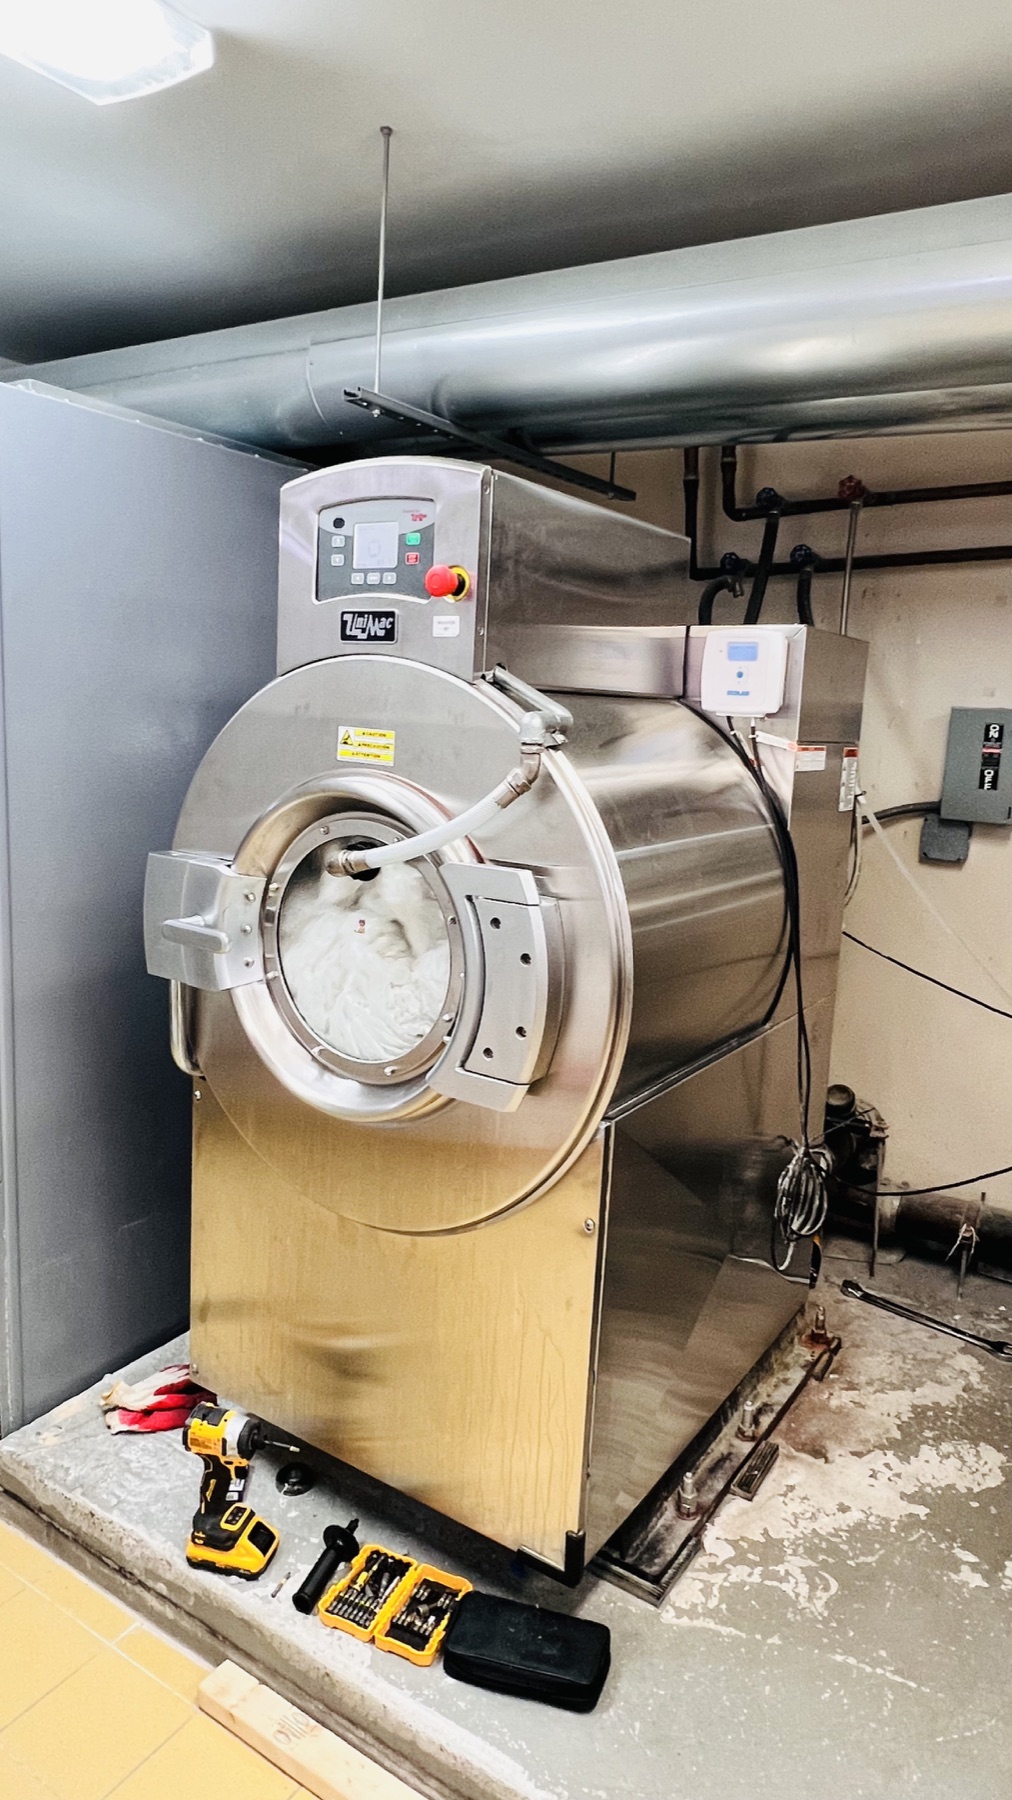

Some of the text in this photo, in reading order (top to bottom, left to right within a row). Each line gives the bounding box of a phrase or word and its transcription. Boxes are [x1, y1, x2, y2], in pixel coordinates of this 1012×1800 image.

[343, 613, 393, 639] UniMac
[989, 724, 1000, 738] ON
[984, 769, 994, 790] OFF
